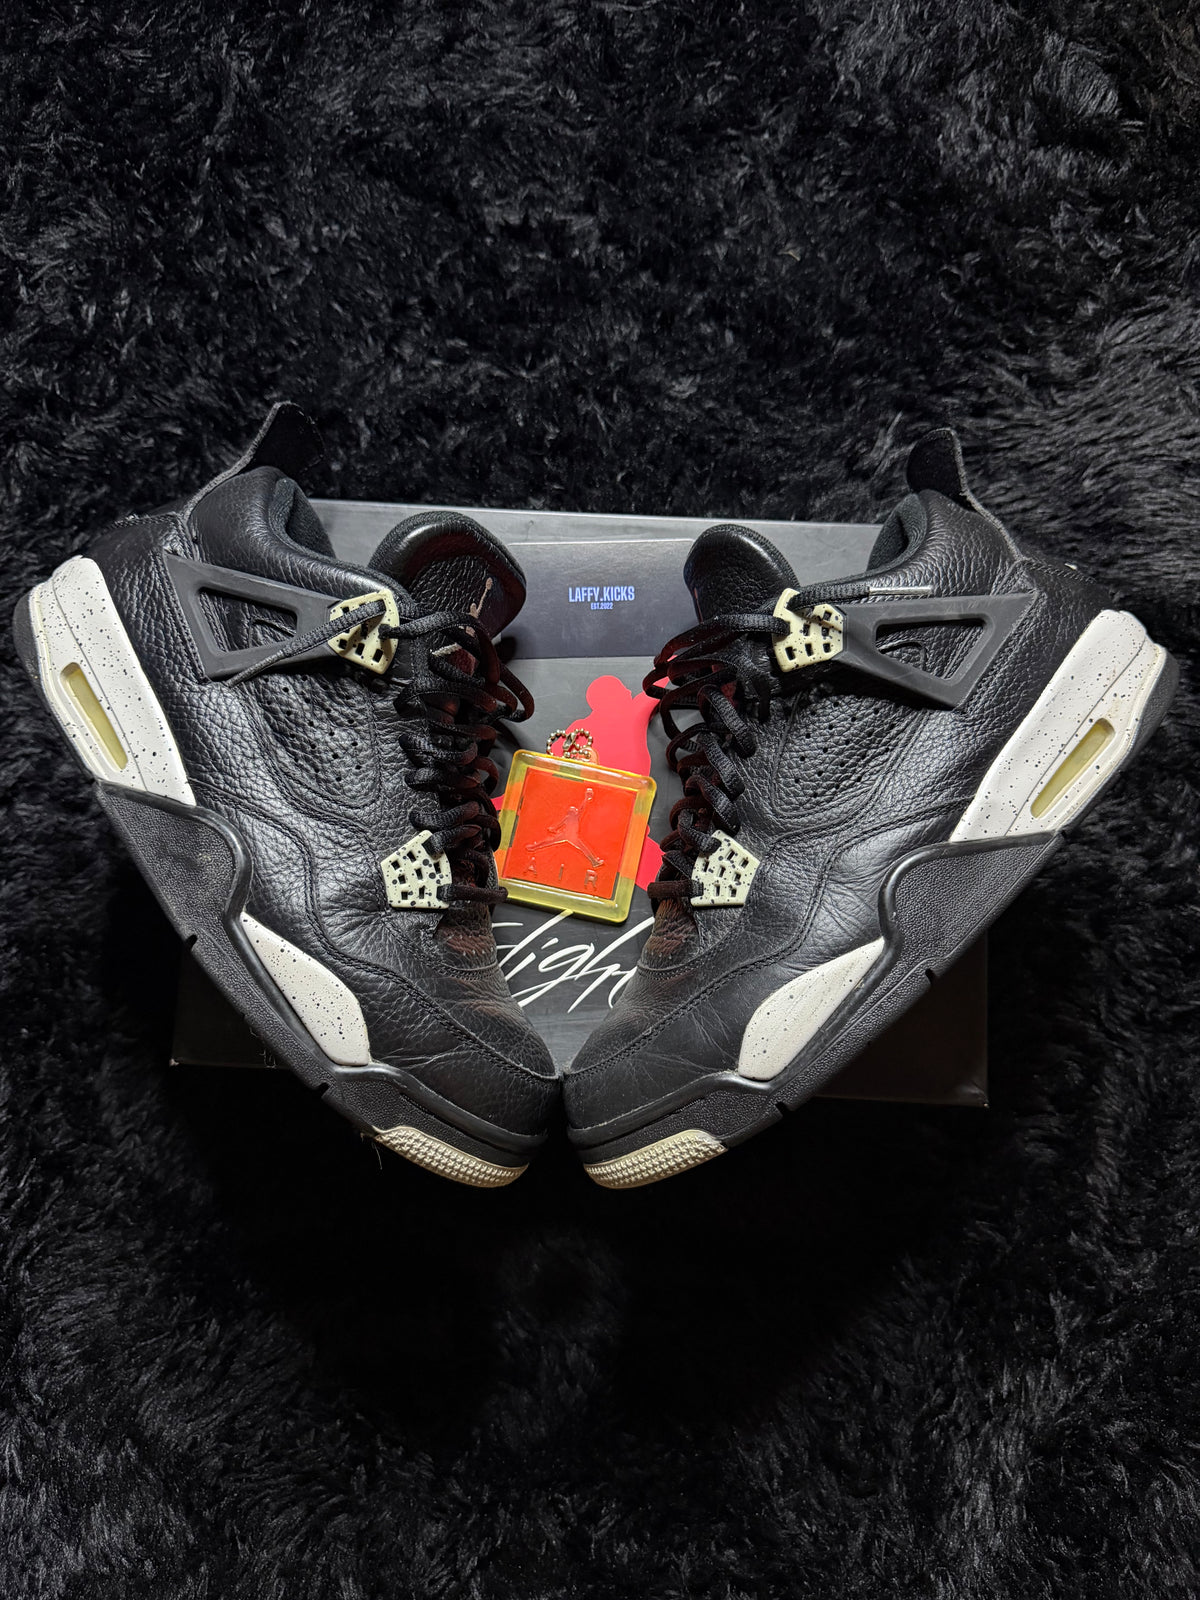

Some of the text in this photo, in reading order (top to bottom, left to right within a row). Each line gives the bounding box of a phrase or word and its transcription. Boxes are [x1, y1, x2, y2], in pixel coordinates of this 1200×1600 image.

[568, 585, 635, 602] LAFFY.KICKS
[590, 602, 614, 610] EST.2022
[523, 857, 598, 891] AIR
